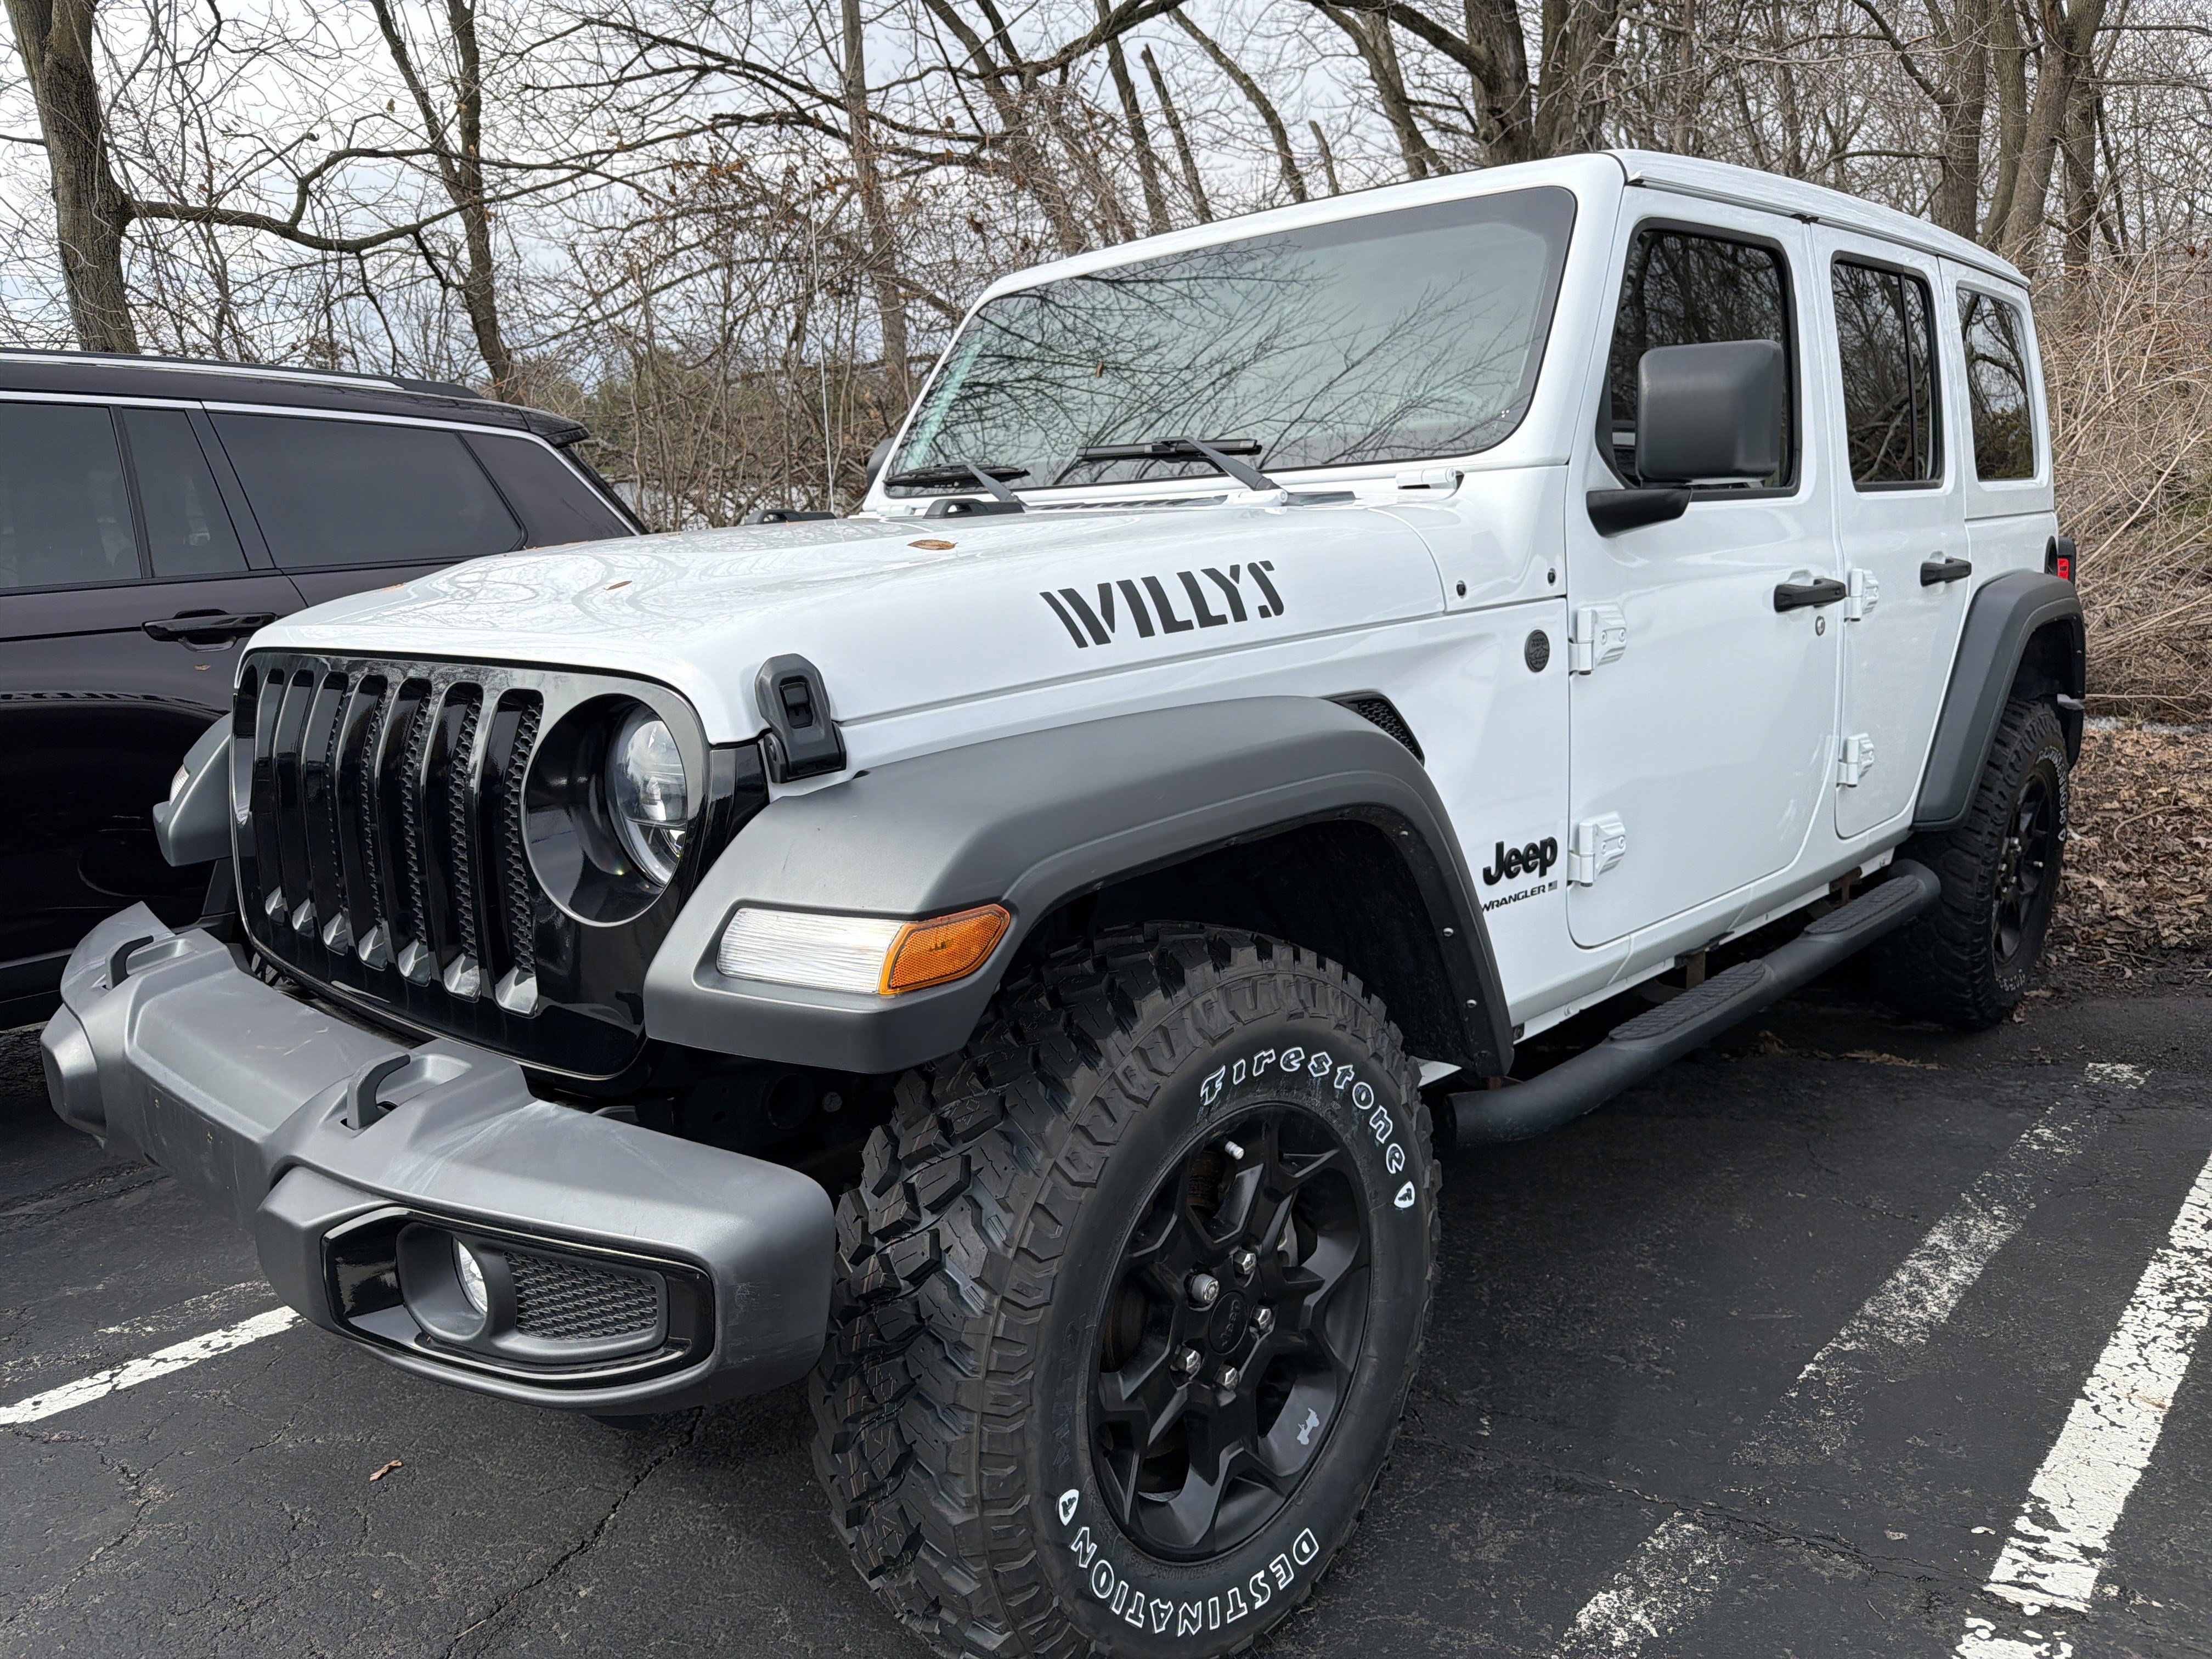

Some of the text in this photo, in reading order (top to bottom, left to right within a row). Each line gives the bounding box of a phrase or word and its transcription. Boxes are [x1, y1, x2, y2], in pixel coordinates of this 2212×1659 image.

[1039, 560, 1284, 648] WILLYS
[1481, 884, 1546, 913] WRANGLER
[1482, 836, 1558, 886] Jeep
[1200, 1047, 1406, 1174] Firestone
[1070, 1526, 1319, 1638] DESTINATION
